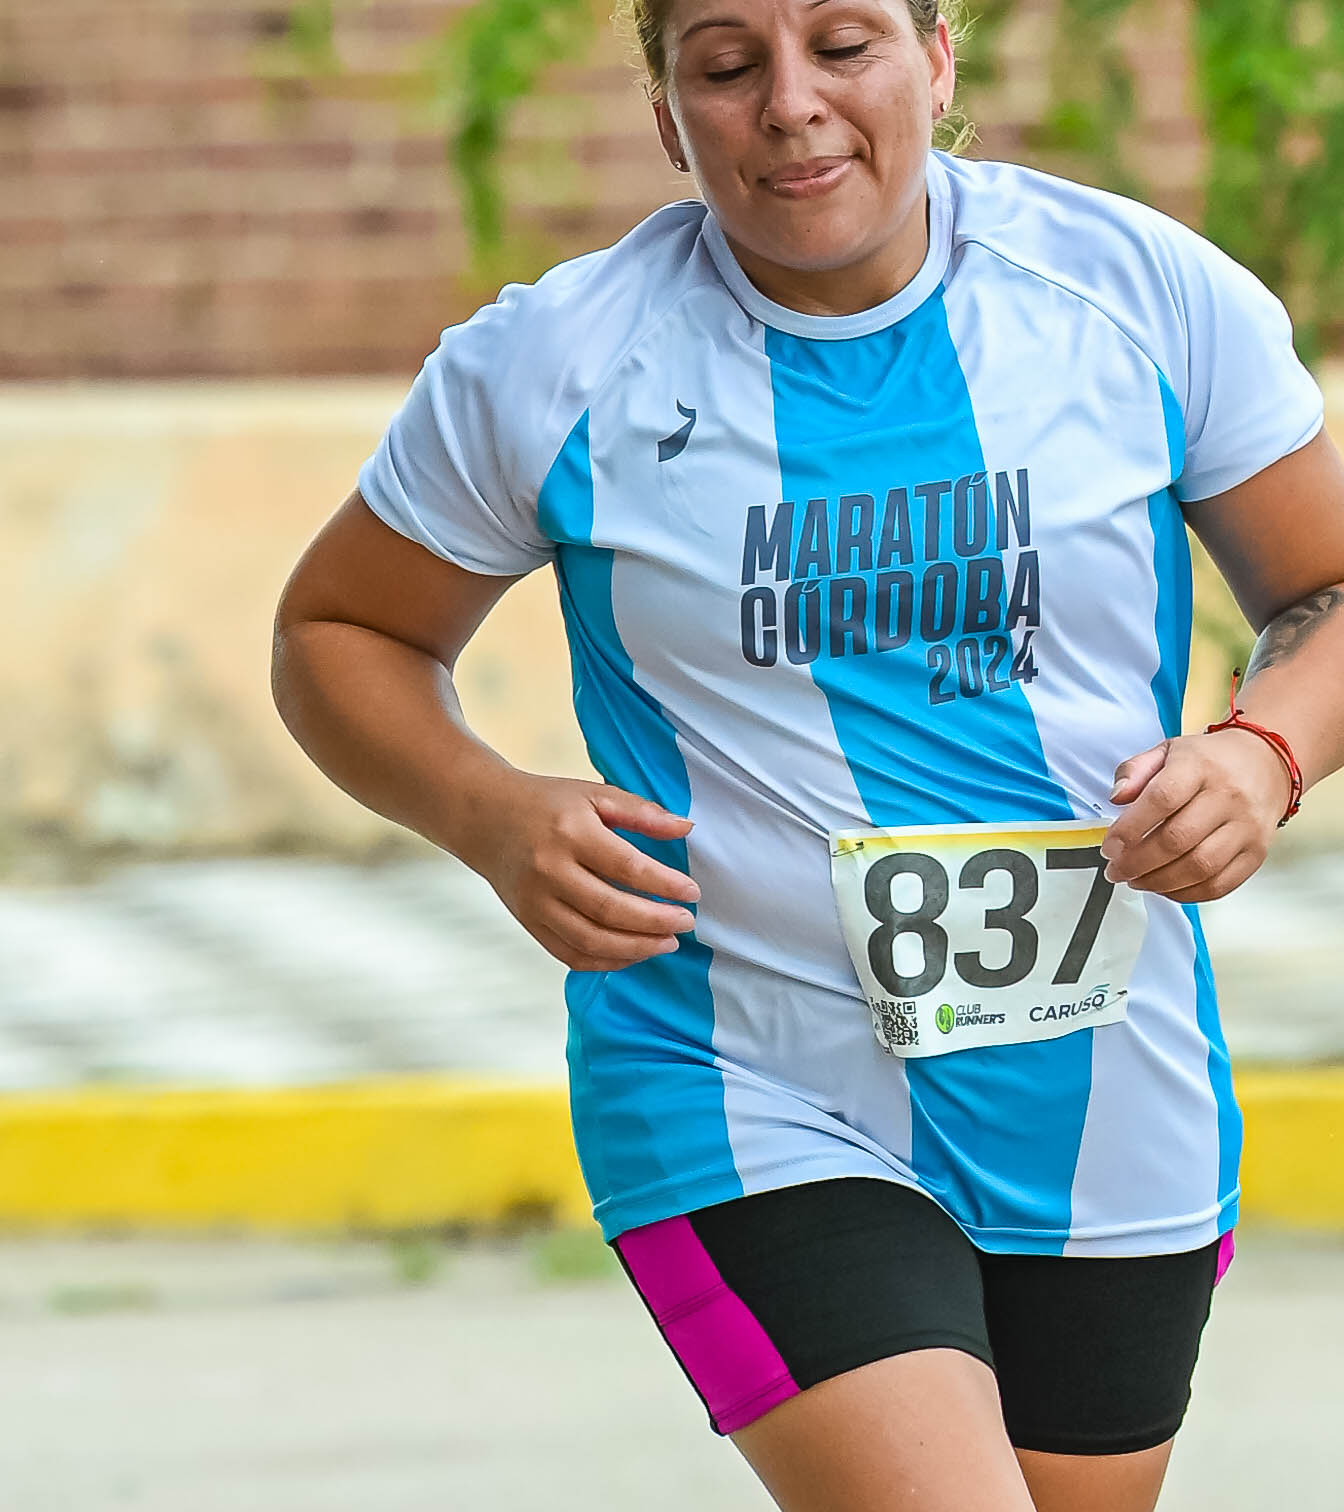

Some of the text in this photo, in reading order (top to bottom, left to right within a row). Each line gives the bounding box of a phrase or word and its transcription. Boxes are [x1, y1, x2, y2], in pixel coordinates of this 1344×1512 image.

[741, 468, 1031, 585] MARATÓN
[740, 550, 1041, 668] CÓRDOBA
[927, 631, 1039, 705] 2024
[864, 845, 1116, 998] 837
[956, 1004, 981, 1015] CLUB
